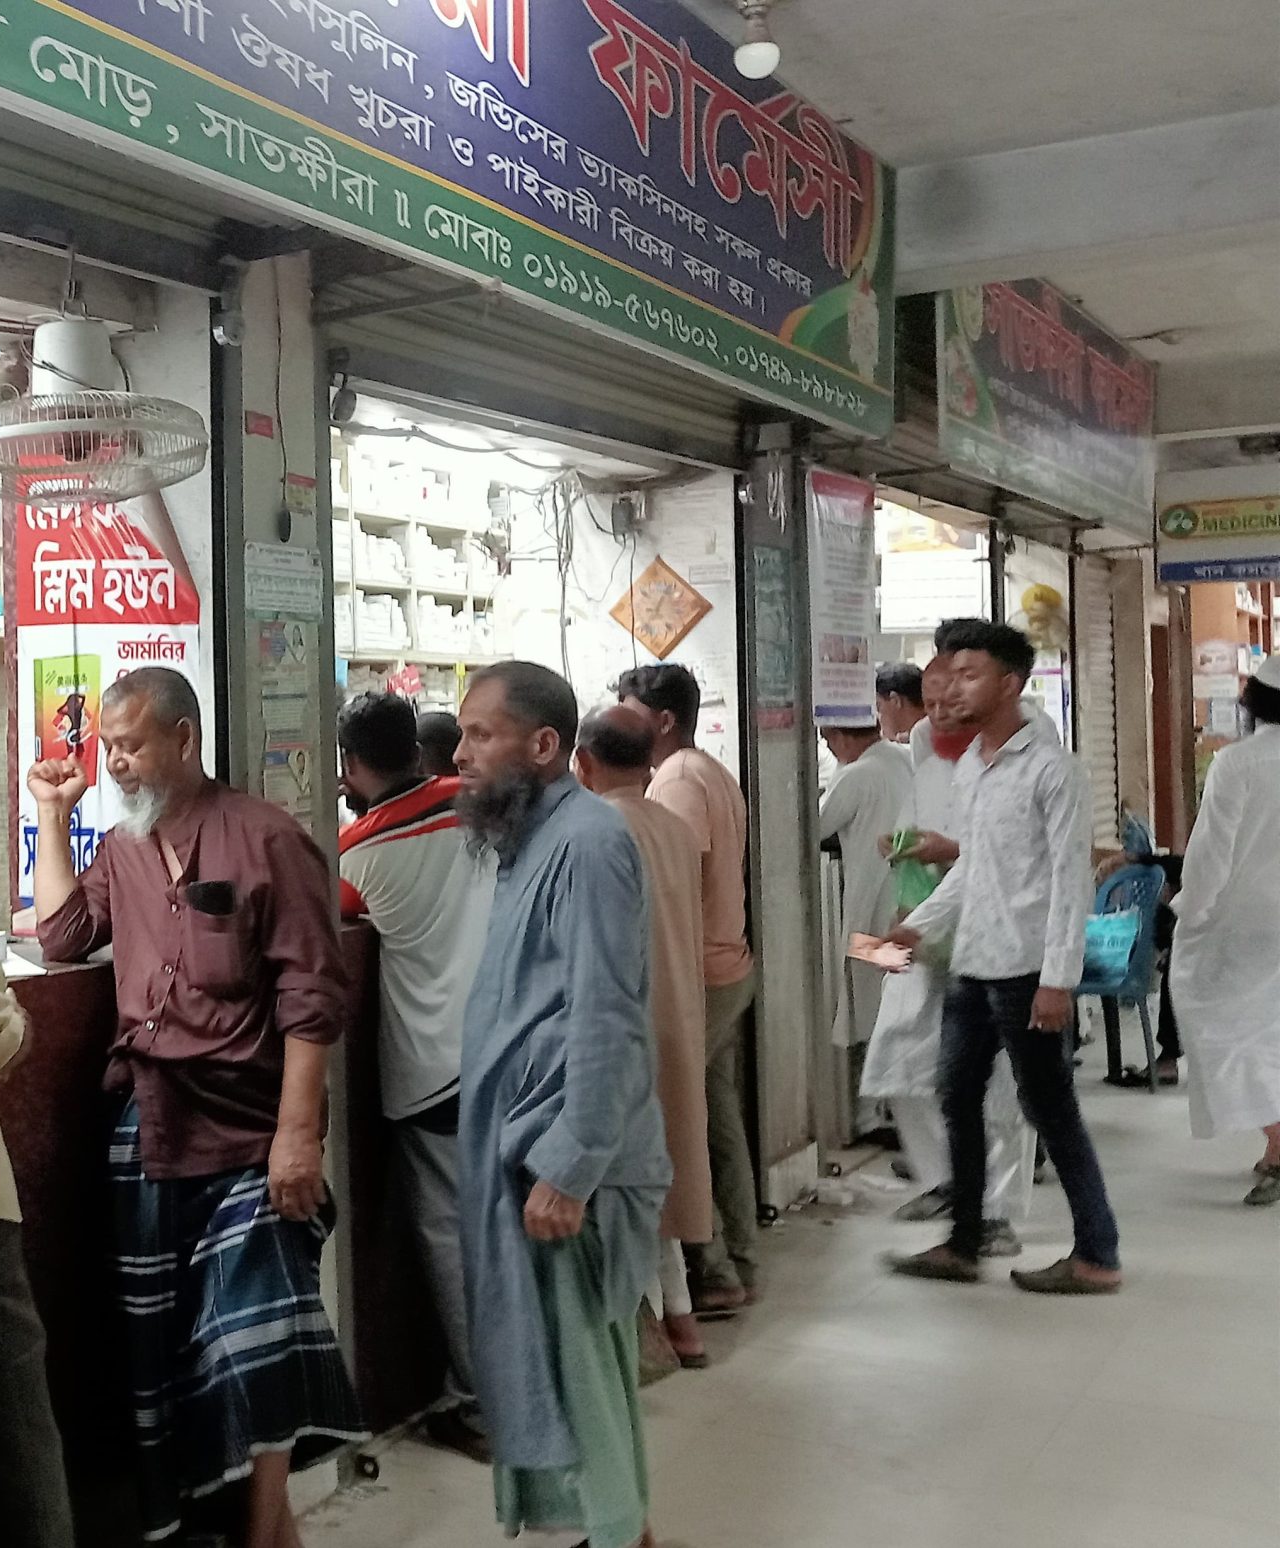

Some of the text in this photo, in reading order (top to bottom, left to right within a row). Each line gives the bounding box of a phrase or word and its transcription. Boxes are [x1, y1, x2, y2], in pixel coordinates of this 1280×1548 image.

[194, 101, 380, 217] সাতক্ষীরা
[231, 13, 335, 105] ঔষধ
[348, 83, 436, 151] খুচরা
[447, 132, 475, 167] ও
[486, 152, 602, 232] পাইকারী
[608, 206, 675, 269] বিক্রয়
[679, 251, 722, 293] করা
[575, 145, 710, 243] ভ্যাকসিনসহ
[714, 224, 762, 271] সকল
[767, 257, 813, 298] প্রকার
[32, 540, 176, 616] স্লিম হউন
[117, 632, 186, 661] জার্মানির
